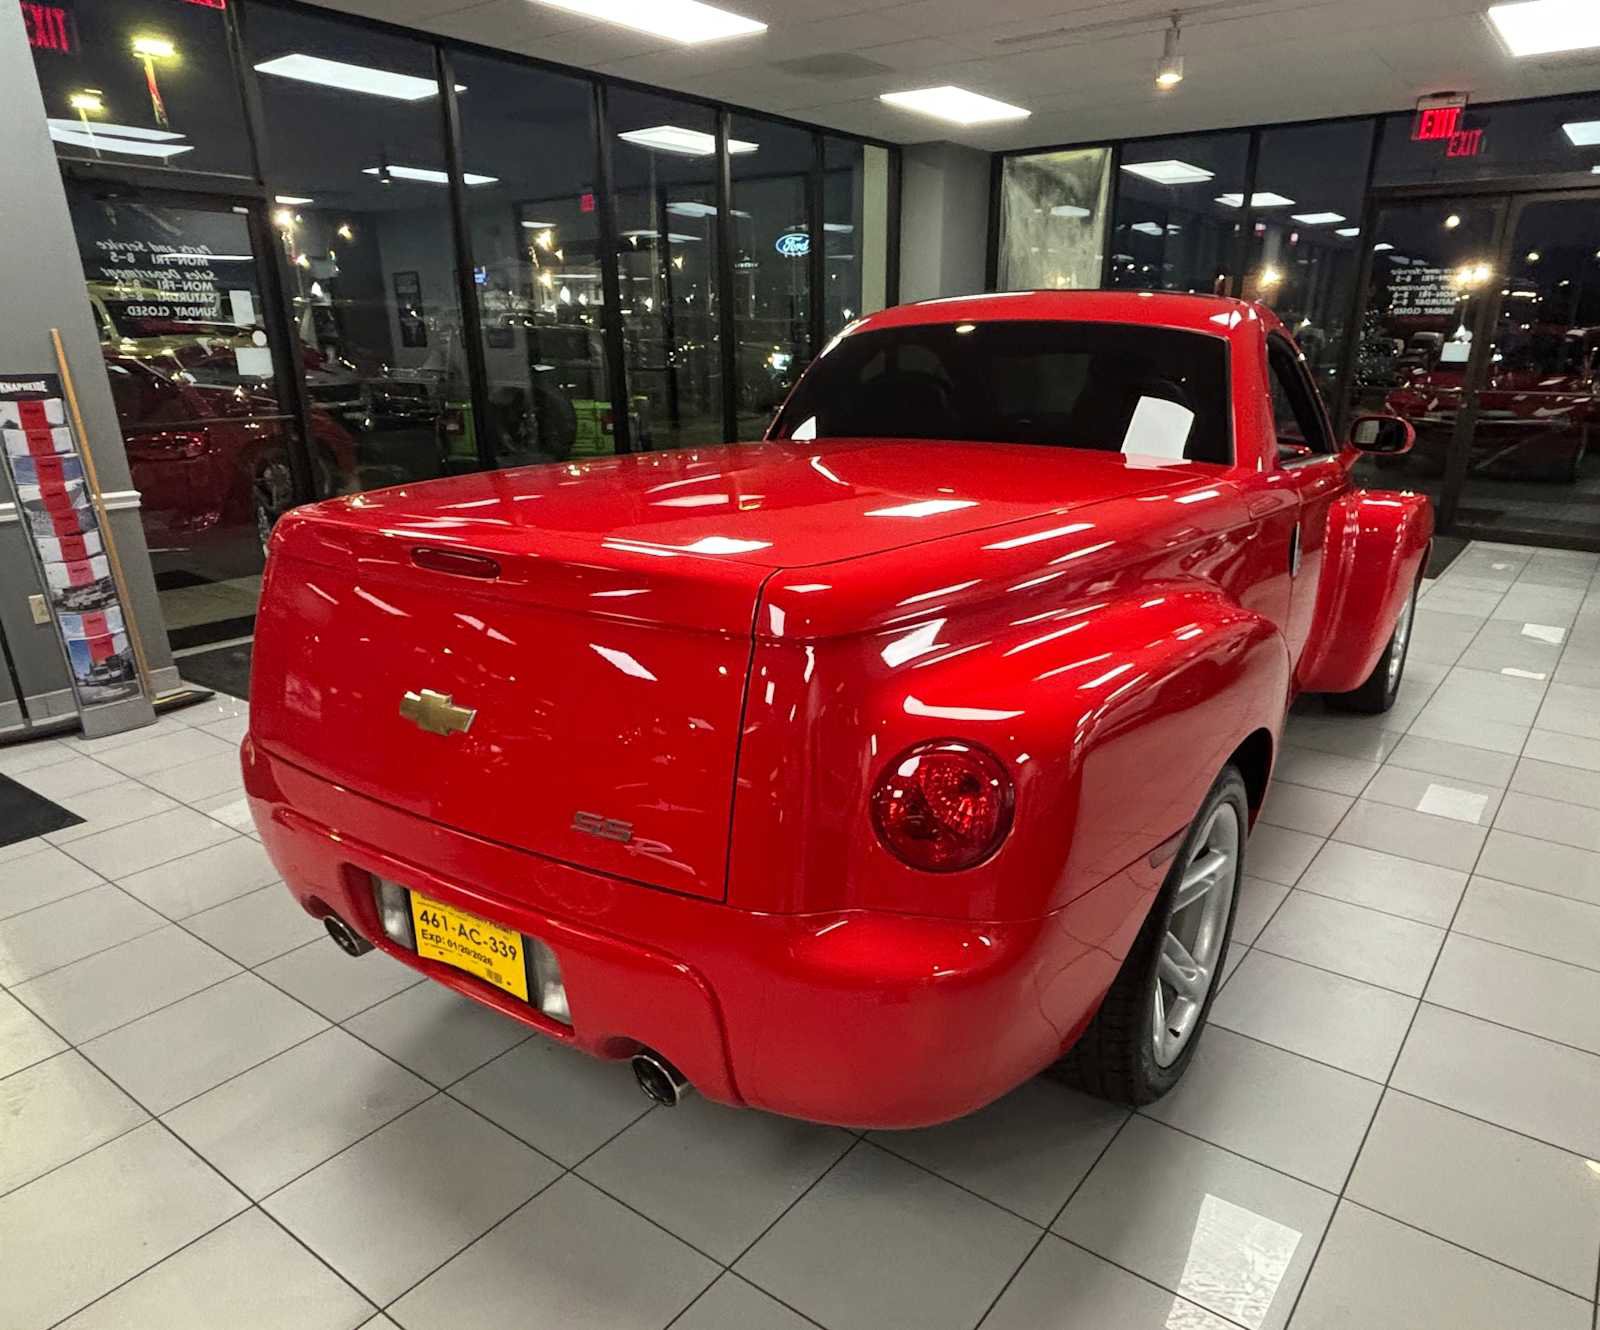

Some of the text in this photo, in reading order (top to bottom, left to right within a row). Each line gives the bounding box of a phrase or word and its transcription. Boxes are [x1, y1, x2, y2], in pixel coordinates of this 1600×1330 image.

[1419, 107, 1460, 140] EXIT
[1446, 129, 1483, 157] EXIT
[420, 909, 517, 961] 461-AC-339
